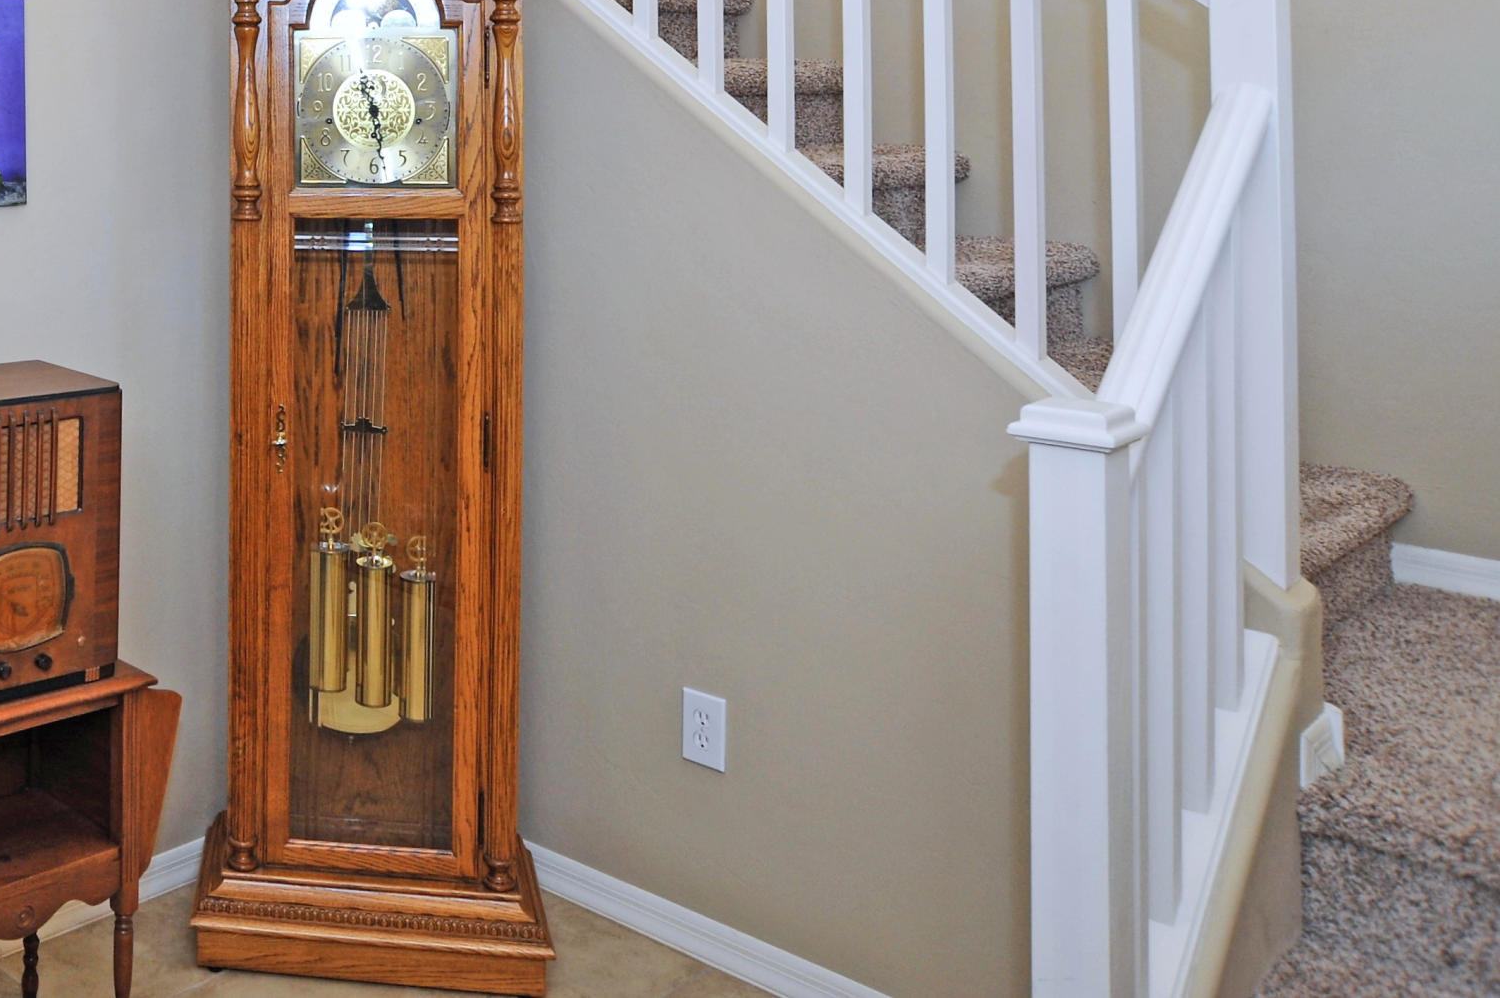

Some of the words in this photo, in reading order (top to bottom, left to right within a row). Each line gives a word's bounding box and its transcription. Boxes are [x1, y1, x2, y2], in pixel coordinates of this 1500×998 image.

[339, 54, 352, 72] 11
[317, 72, 334, 92] 10
[416, 72, 428, 92] 2
[312, 100, 324, 121] 9
[422, 99, 437, 121] 3
[320, 128, 332, 147] 8
[340, 149, 351, 166] 7
[369, 156, 379, 175] 6
[397, 149, 408, 167] 5
